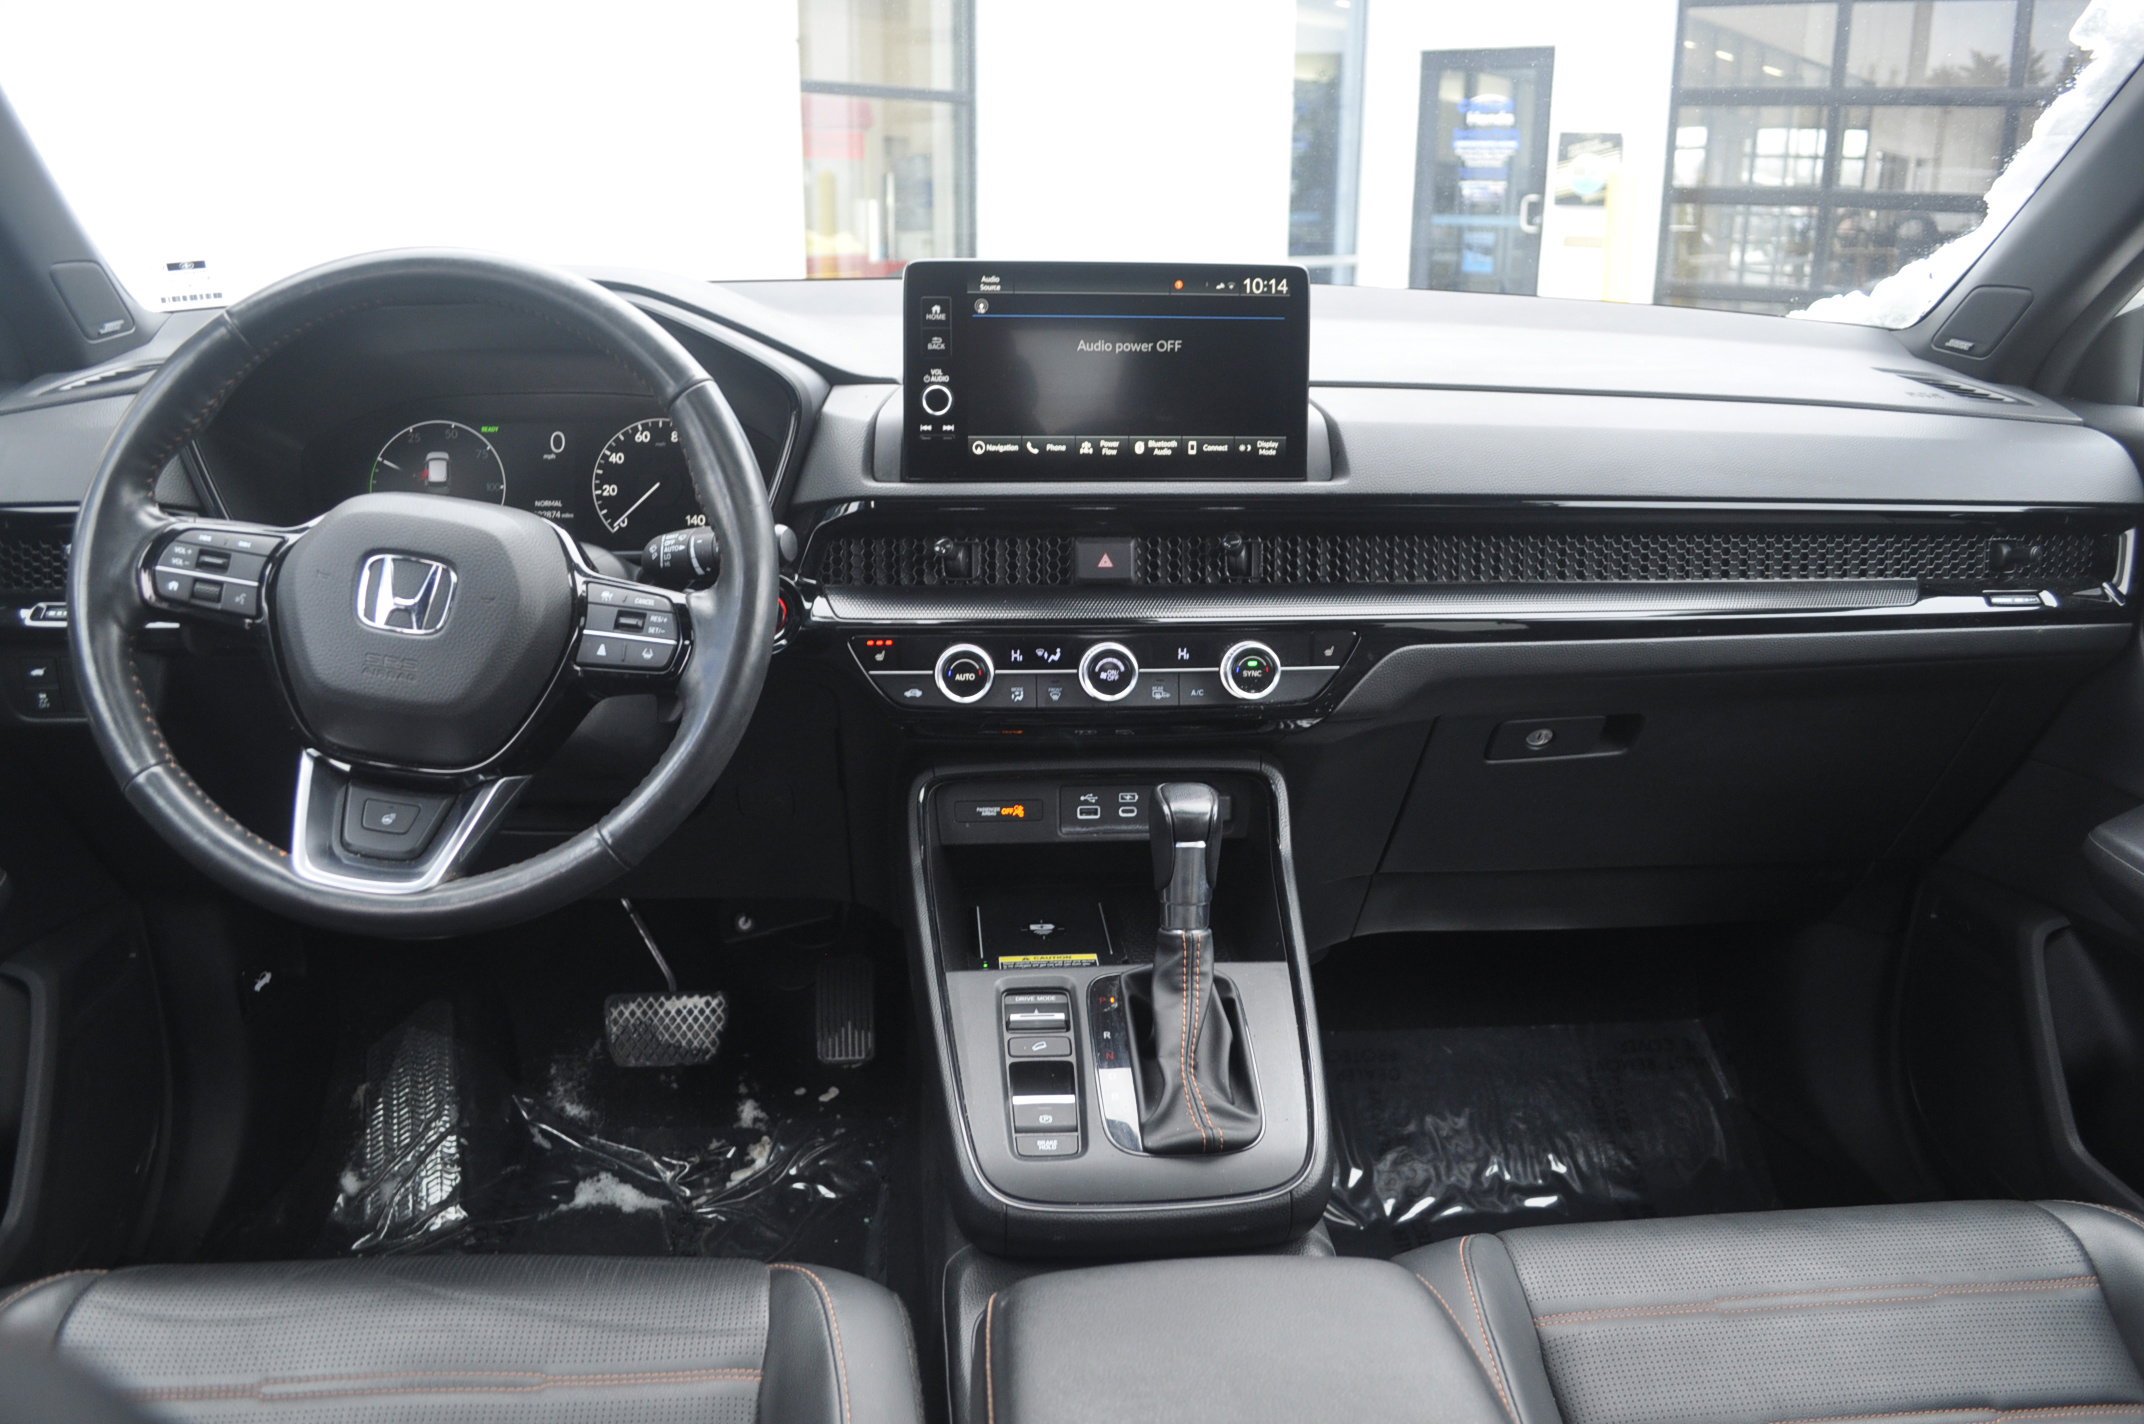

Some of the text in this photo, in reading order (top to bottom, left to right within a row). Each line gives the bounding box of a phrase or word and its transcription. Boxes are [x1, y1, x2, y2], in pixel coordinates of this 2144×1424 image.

[980, 275, 1000, 284] Audio
[980, 283, 1001, 291] Source
[1243, 277, 1288, 295] 10:14
[926, 313, 946, 321] HOME
[1077, 339, 1182, 354] Audio power OFF
[930, 368, 942, 376] VOL
[481, 425, 499, 433] READY
[634, 430, 651, 443] 60
[550, 431, 565, 453] 0
[1100, 439, 1120, 448] Power
[1148, 439, 1178, 449] Bluetooth
[1256, 440, 1279, 449] Display
[986, 443, 1019, 453] Navigation
[1046, 443, 1066, 452] Phone
[1101, 448, 1117, 456] Flow
[1153, 448, 1172, 456] Audio
[1202, 443, 1228, 452] Connect
[1258, 448, 1277, 456] Mode
[608, 452, 625, 464] 40
[602, 484, 618, 496] 20
[685, 514, 706, 526] 140
[954, 672, 976, 681] AUTO
[1242, 670, 1263, 678] SYNC
[1190, 688, 1205, 697] A/C
[1001, 807, 1014, 816] OFF
[1103, 1031, 1111, 1039] R
[1105, 1051, 1115, 1060] N
